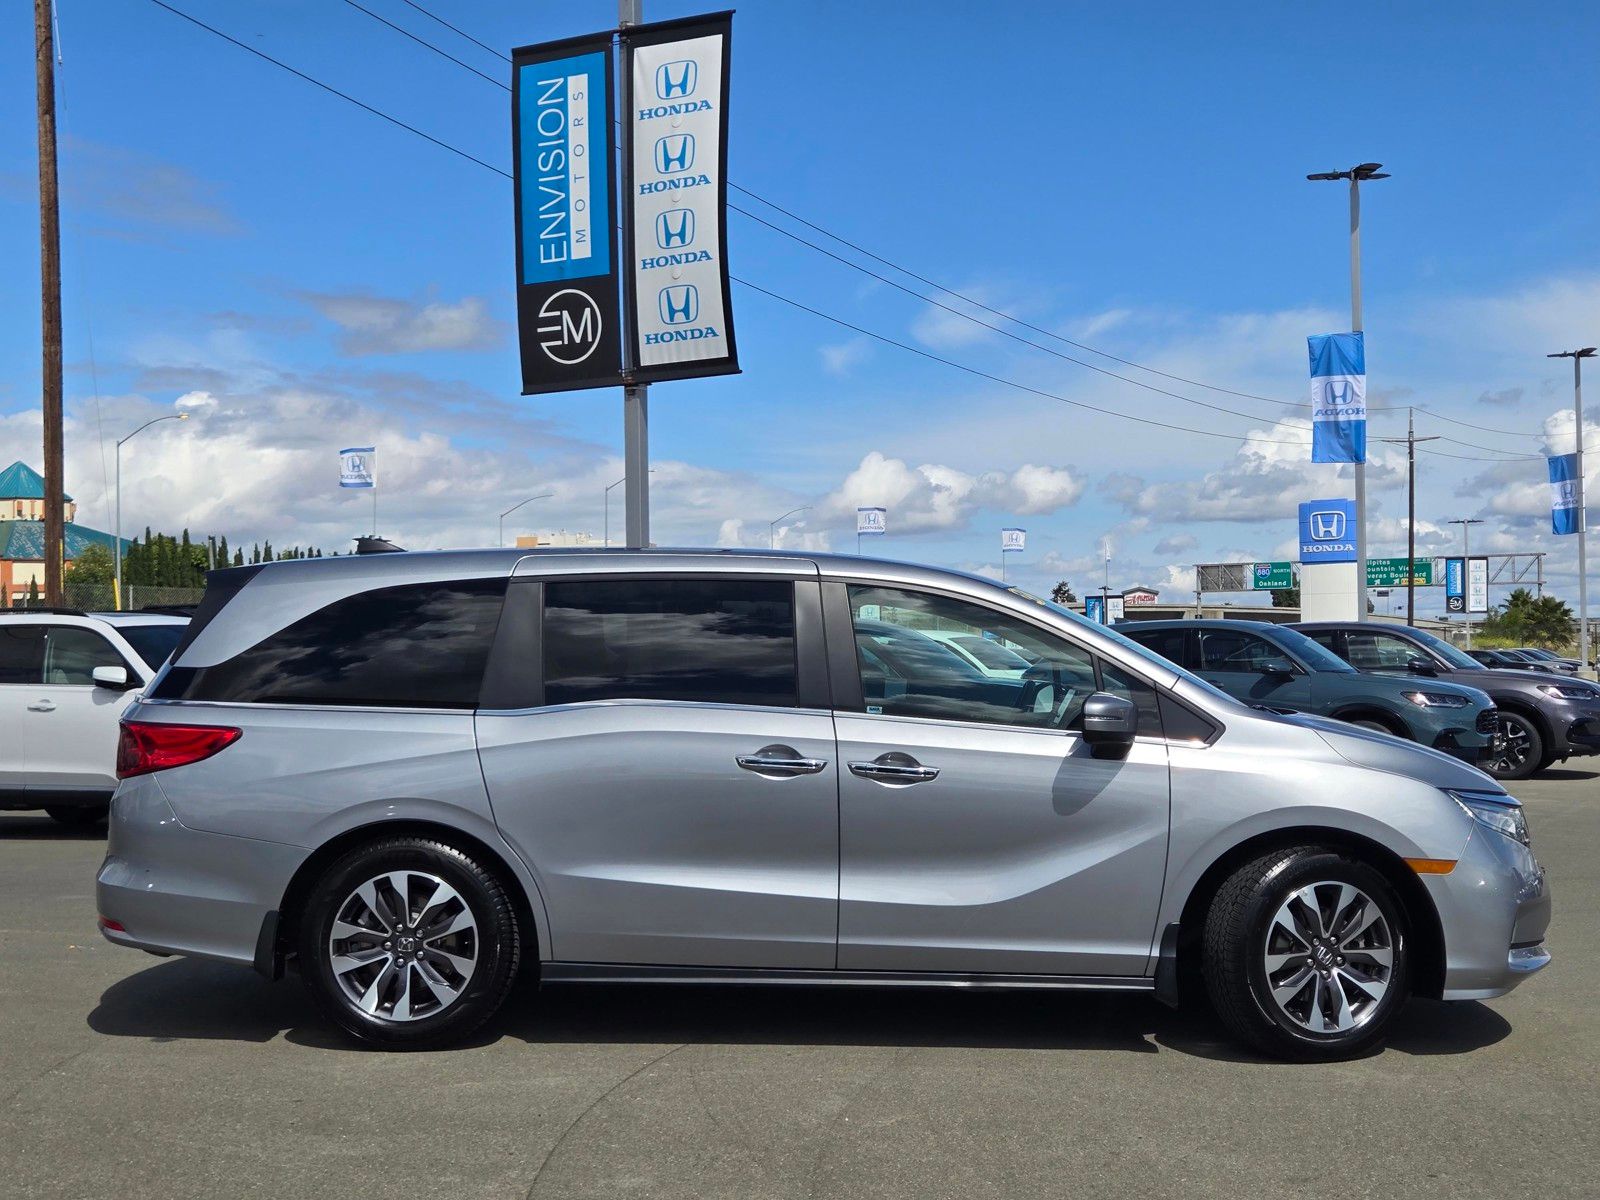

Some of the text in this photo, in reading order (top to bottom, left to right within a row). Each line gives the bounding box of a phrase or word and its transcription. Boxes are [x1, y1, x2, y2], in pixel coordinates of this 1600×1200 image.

[638, 100, 713, 121] HONDA
[537, 77, 567, 264] ENVISION
[572, 91, 586, 243] MOTORS
[639, 174, 712, 195] HONDA
[641, 250, 713, 270] HONDA
[644, 327, 720, 345] HONDA
[1302, 543, 1356, 553] HONDA
[1257, 568, 1270, 576] 880
